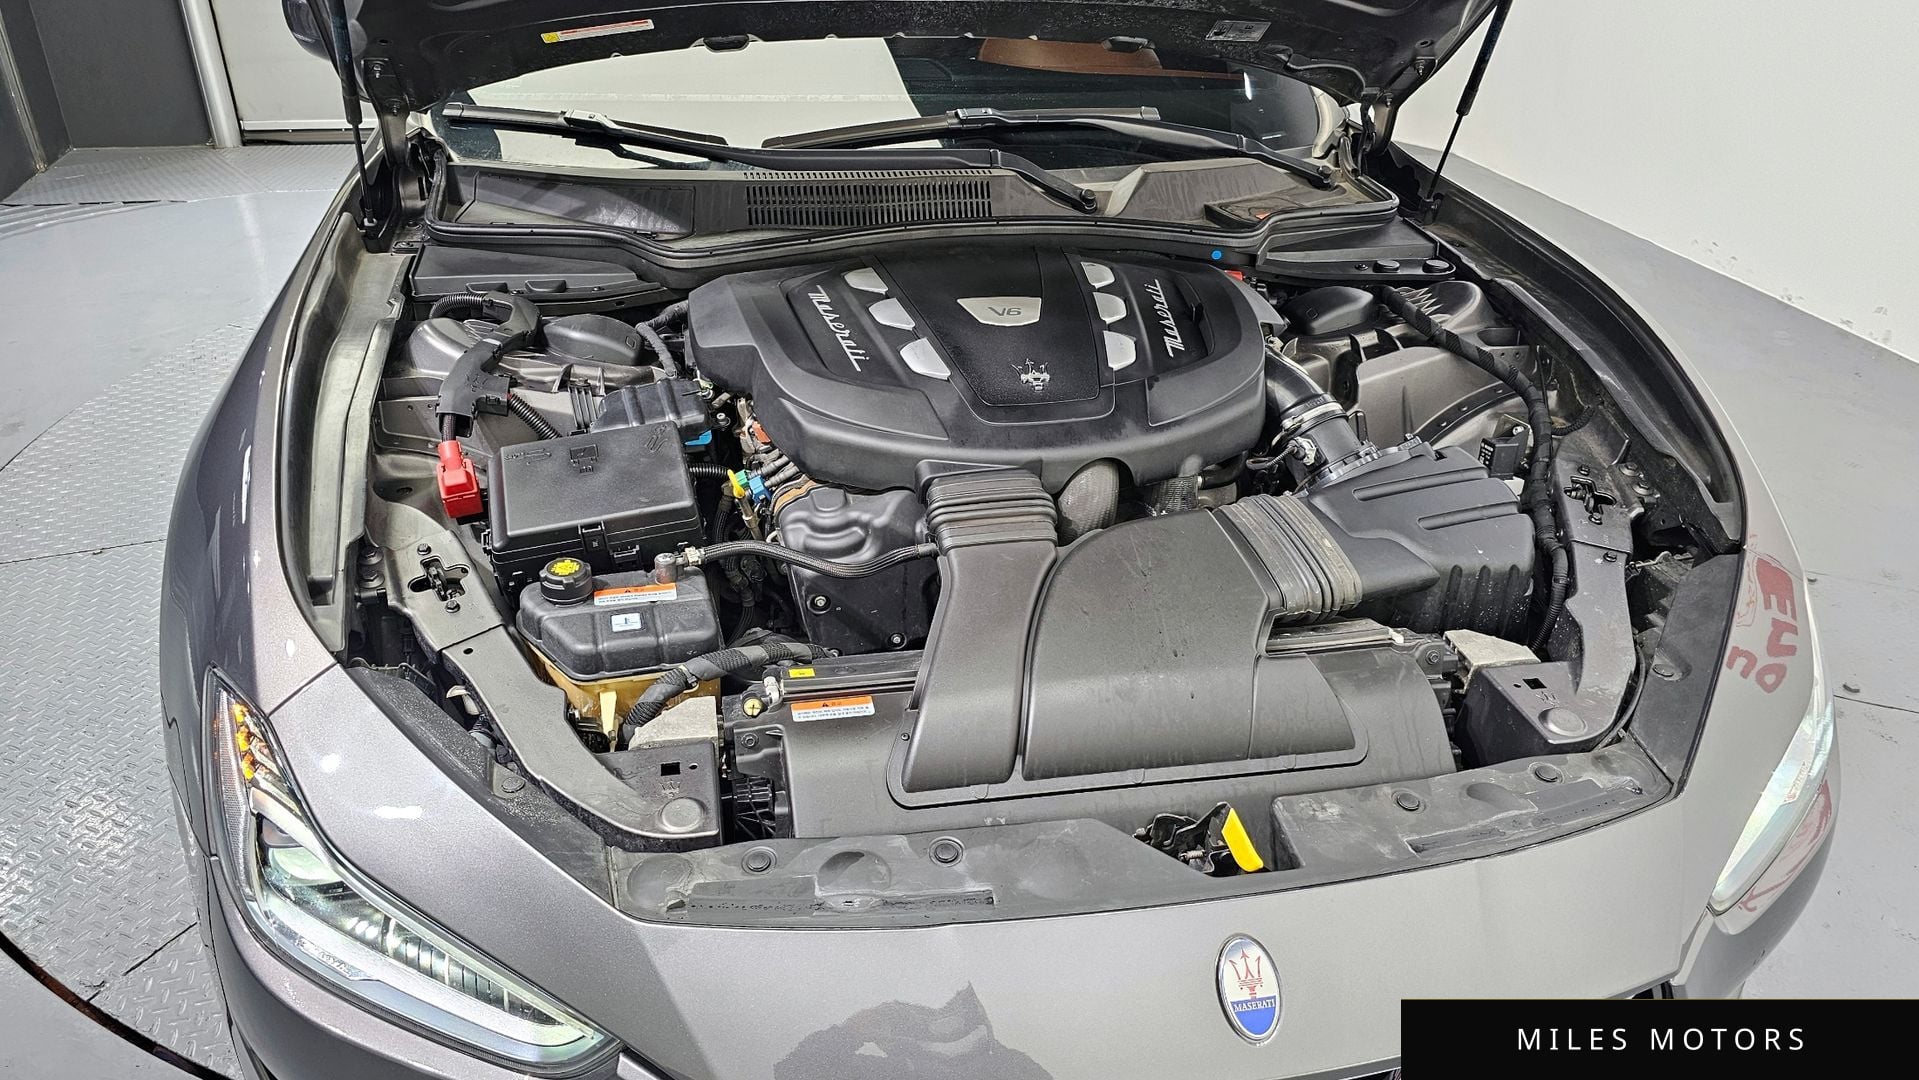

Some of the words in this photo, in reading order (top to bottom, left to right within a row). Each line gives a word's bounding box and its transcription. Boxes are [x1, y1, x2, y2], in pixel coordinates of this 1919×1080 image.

[807, 284, 870, 372] Maserati
[987, 306, 1022, 317] V6
[1144, 279, 1185, 358] Maserati
[1233, 998, 1275, 1013] MASERATI
